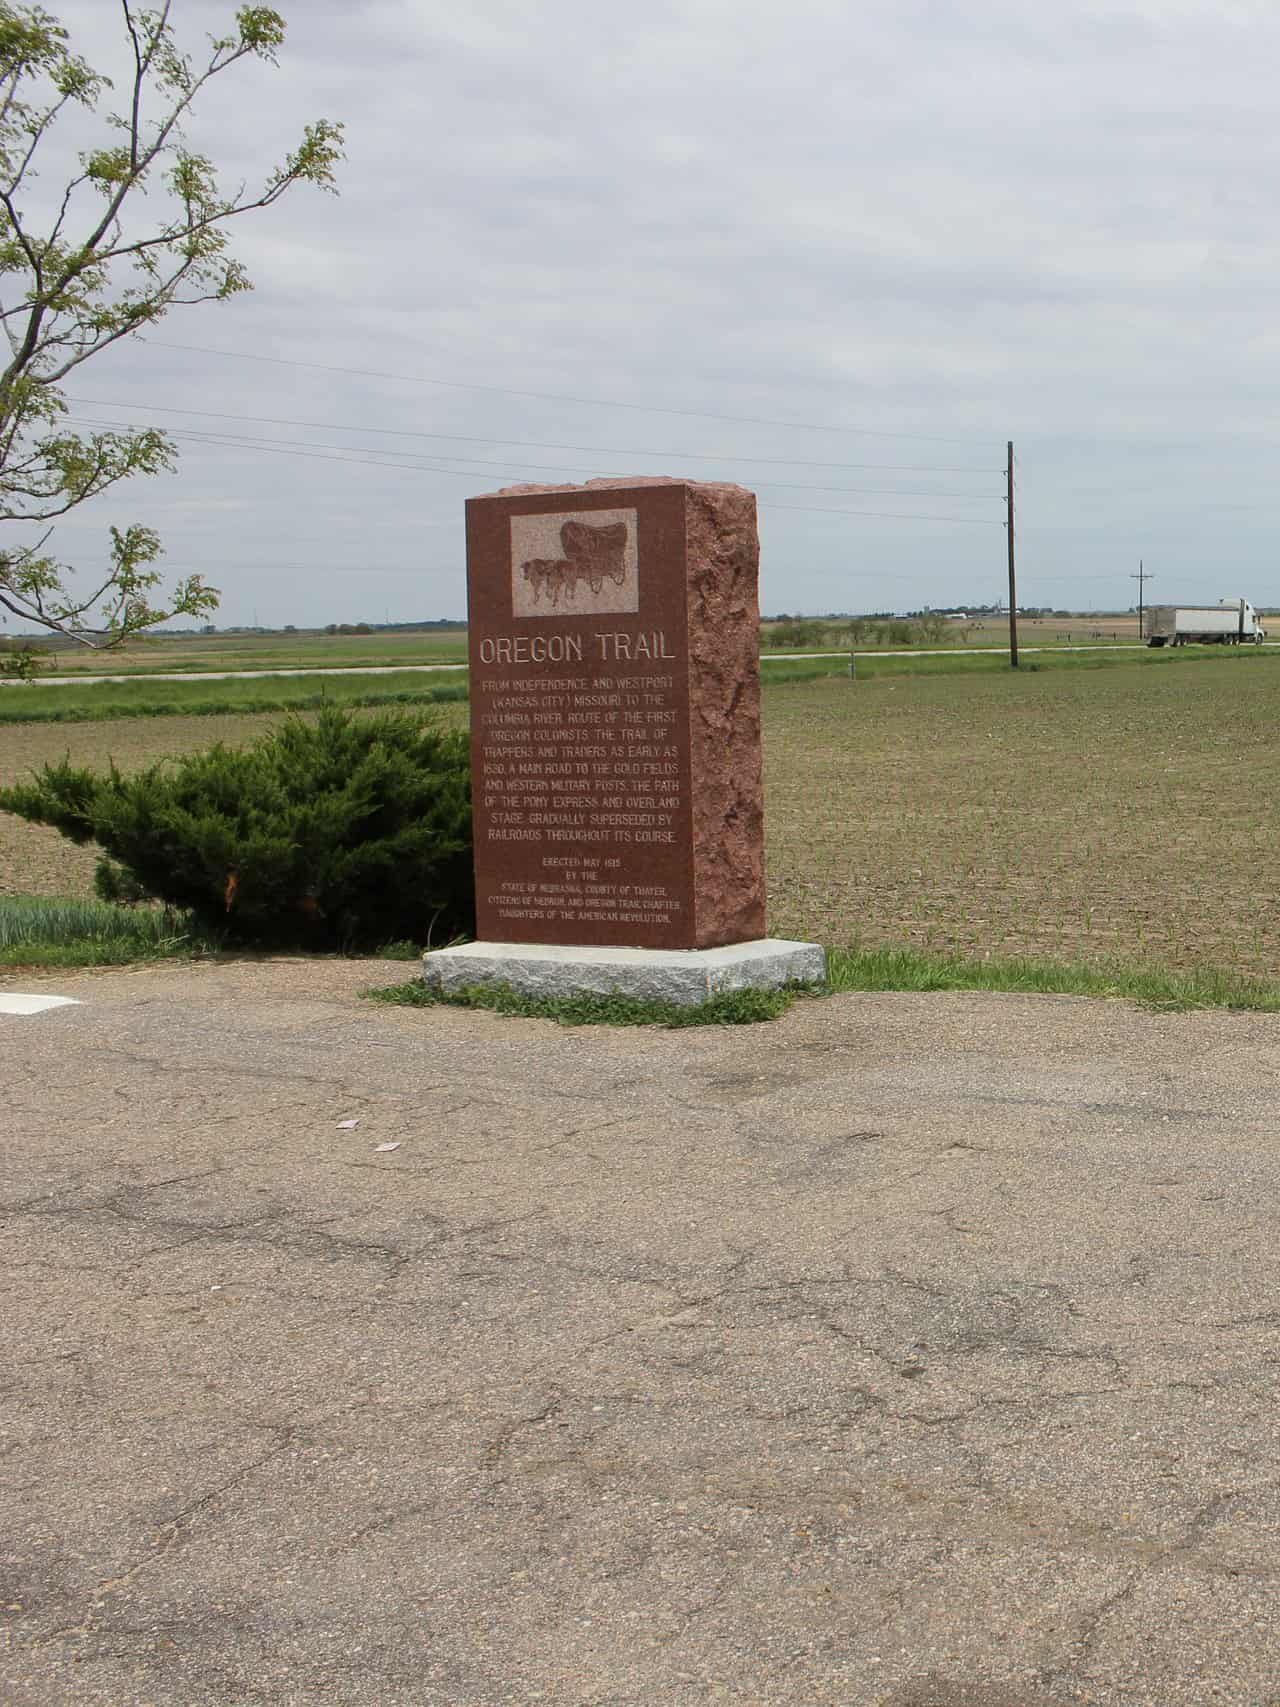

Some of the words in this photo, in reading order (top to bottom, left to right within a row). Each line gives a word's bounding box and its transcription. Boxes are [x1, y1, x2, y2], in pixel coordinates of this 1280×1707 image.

[480, 634, 583, 664] OREGON
[594, 631, 676, 661] TRAIL
[481, 679, 511, 692] FROM
[512, 677, 588, 691] INDEPENDENCE
[592, 676, 613, 689] AND
[615, 675, 673, 688] WESTPORT
[492, 695, 538, 709] (KANSAS
[542, 694, 571, 707] CITY)
[624, 694, 639, 705] TO
[643, 693, 664, 705] THE
[568, 712, 601, 724] ROUTE
[605, 712, 619, 723] OF
[624, 711, 646, 723] THE
[648, 711, 676, 723] FIRST
[491, 730, 530, 742] OREGON
[596, 729, 617, 740] THE
[621, 728, 647, 740] TRAIL
[653, 728, 667, 739] OF
[484, 746, 536, 759] TRAPPERS
[538, 746, 557, 758] AND
[561, 746, 603, 758] TRADERS
[611, 746, 624, 757] AS
[628, 746, 660, 757] EARLY
[664, 746, 679, 757] AS
[508, 763, 516, 774] A
[519, 763, 542, 774] MAIN
[545, 763, 571, 774] ROAD
[575, 763, 588, 774] TO
[592, 763, 611, 774] THE
[614, 763, 640, 774] GOLD
[485, 780, 503, 792] AND
[506, 780, 548, 792] WESTERN
[551, 780, 590, 792] MILITARY
[632, 780, 651, 792] THE
[654, 780, 680, 792] PATH
[485, 796, 497, 809] OF
[502, 796, 520, 808] THE
[524, 796, 549, 808] PONY
[553, 796, 598, 808] EXPRESS
[602, 796, 622, 808] AND
[626, 796, 680, 808] OVERLAND
[529, 813, 585, 825] GRADUALLY
[589, 814, 656, 826] SUPERSEDED
[658, 814, 672, 826] BY
[488, 829, 542, 841] RAILROADS
[545, 830, 611, 841] THROUGHOUT
[615, 831, 630, 842] ITS
[543, 857, 579, 867] ERECTED
[583, 857, 600, 867] MAY
[566, 871, 577, 881] BY
[581, 871, 598, 881] THE
[527, 883, 537, 893] OF
[619, 886, 631, 896] OF
[522, 896, 531, 905] OF
[547, 910, 557, 920] OF
[560, 911, 575, 920] THE
[578, 912, 618, 921] AMERICAN
